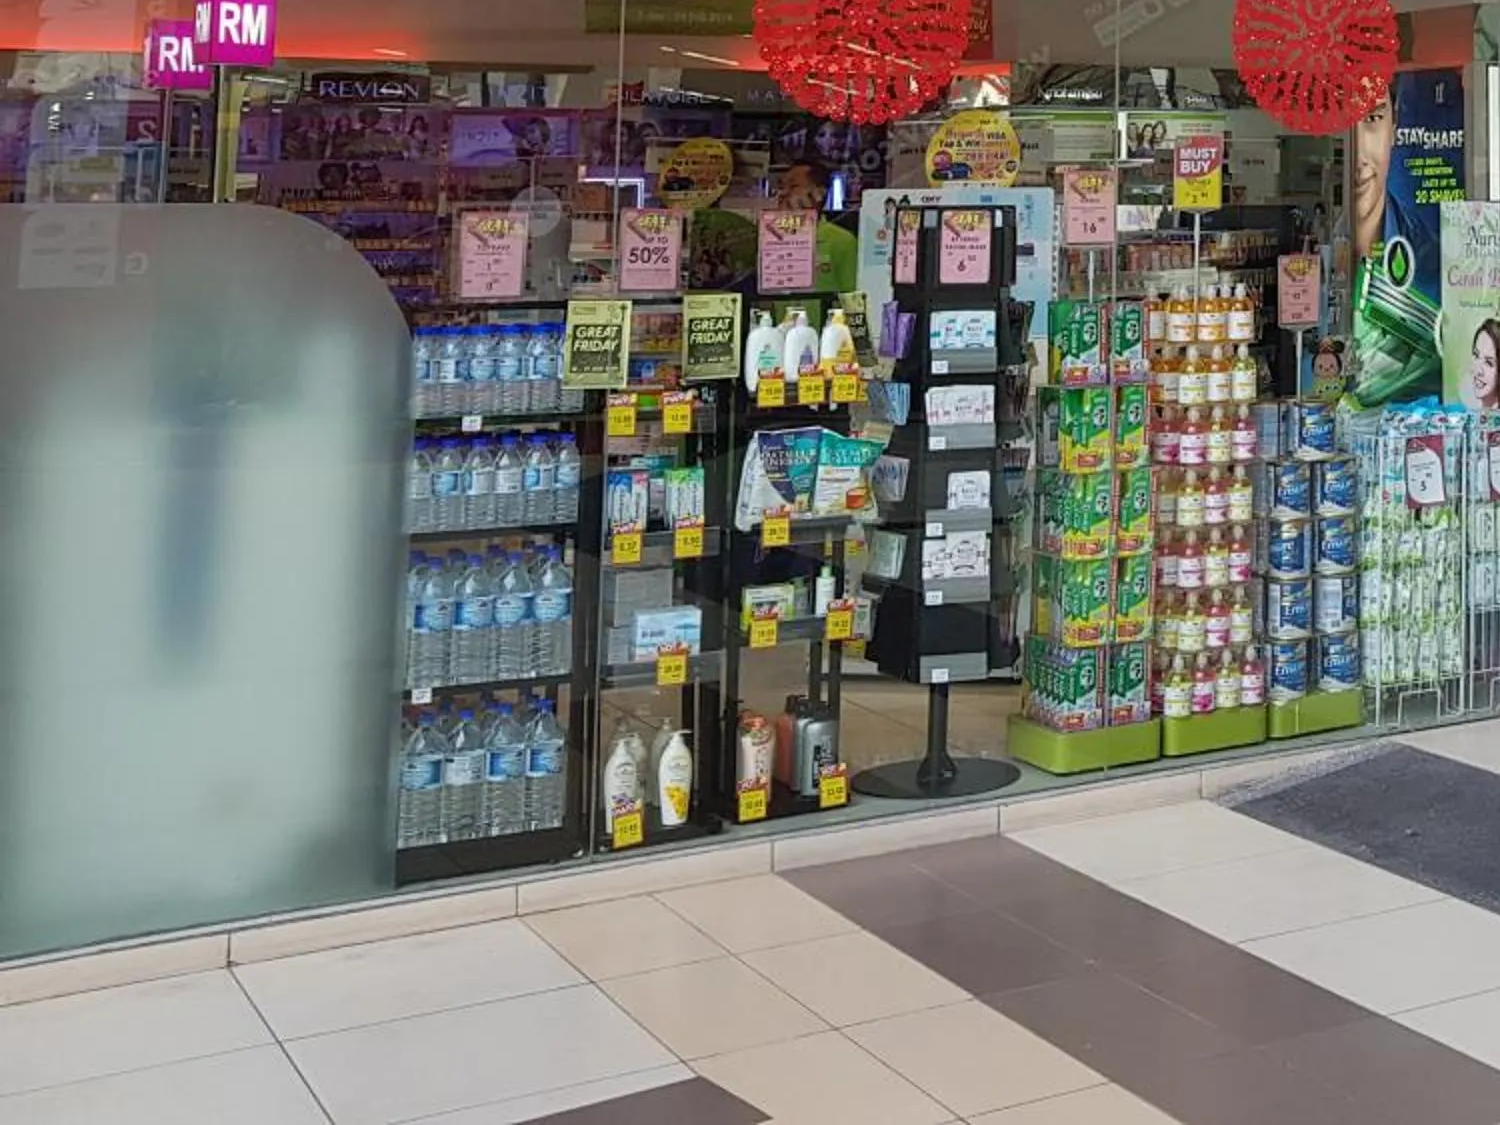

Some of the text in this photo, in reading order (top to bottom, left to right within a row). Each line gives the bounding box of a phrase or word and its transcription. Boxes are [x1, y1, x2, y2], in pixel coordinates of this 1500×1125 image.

[218, 0, 268, 46] RM
[319, 79, 420, 100] REVLON
[1397, 127, 1425, 146] STAY
[1179, 148, 1218, 161] MUST
[1180, 160, 1212, 174] BUY
[628, 246, 670, 265] 50%
[690, 318, 730, 332] GREAT
[575, 326, 620, 339] GREAT
[689, 331, 733, 345] FRIDAY
[573, 339, 619, 353] FRIDAY
